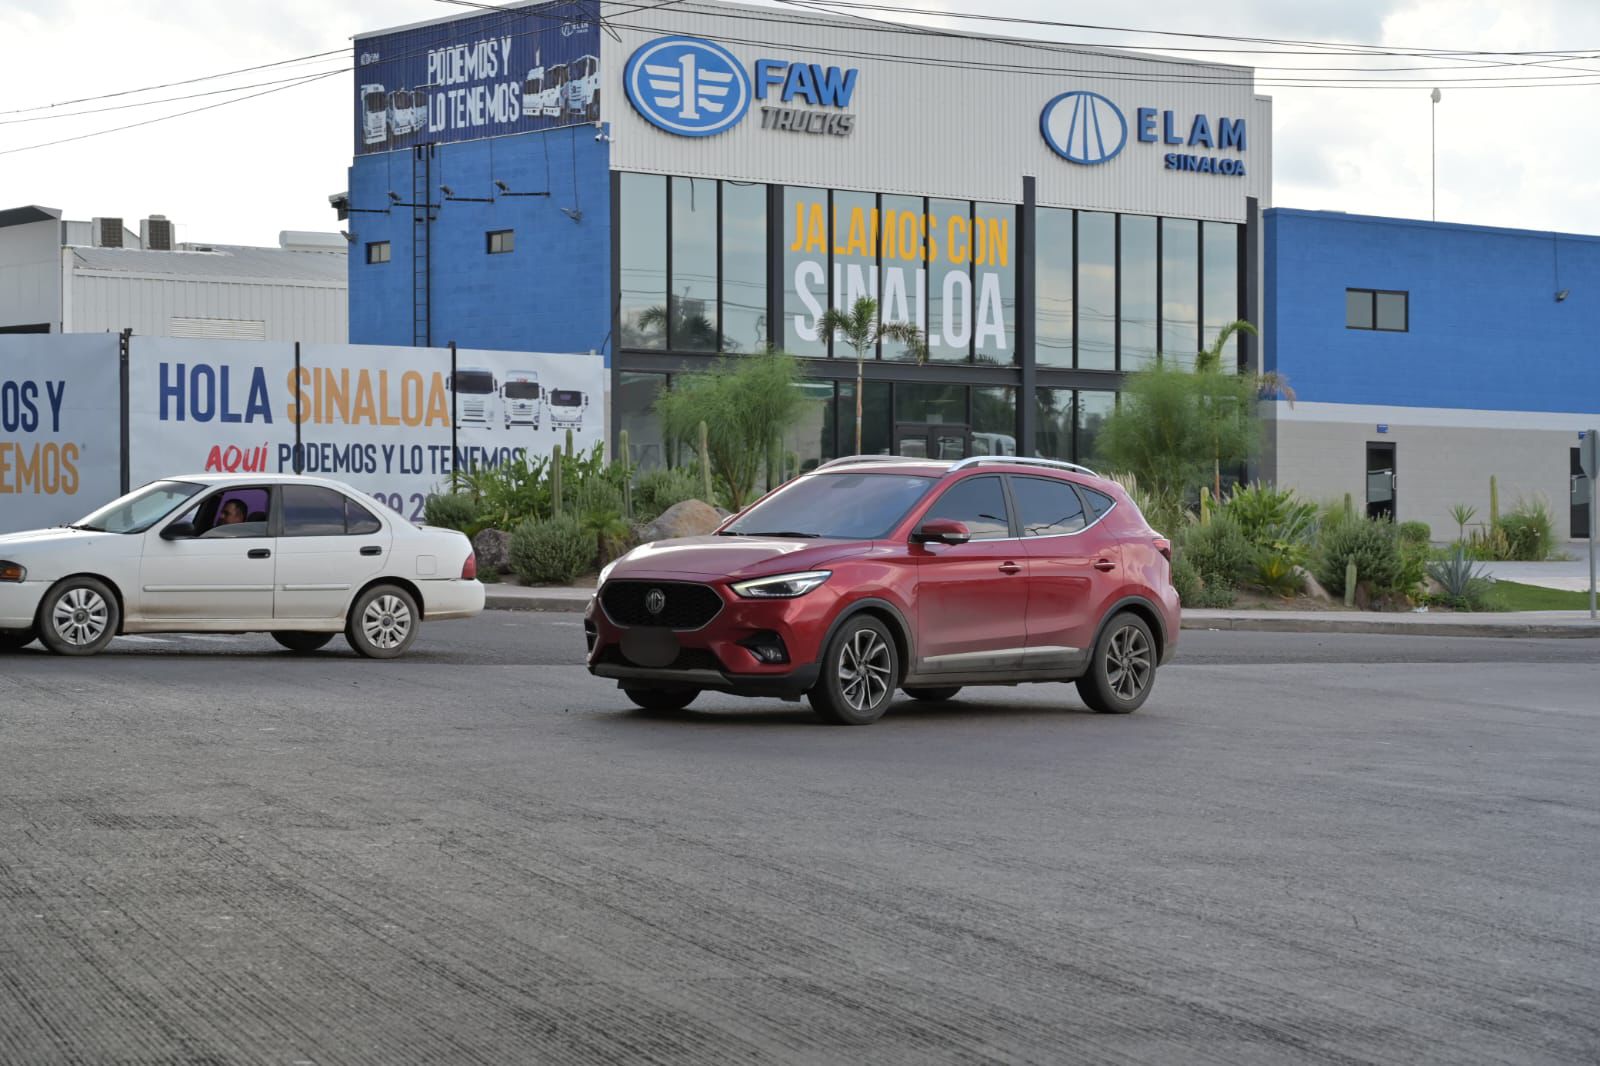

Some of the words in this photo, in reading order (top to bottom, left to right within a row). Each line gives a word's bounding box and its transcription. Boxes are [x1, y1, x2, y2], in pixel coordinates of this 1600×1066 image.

[428, 38, 498, 86] PODEMOS
[500, 35, 513, 76] Y
[755, 58, 859, 108] FAW
[429, 91, 444, 133] LO
[448, 81, 520, 129] TENEMOS
[761, 105, 856, 136] TRUCKS
[1137, 107, 1247, 150] ELAM
[1164, 152, 1246, 176] SINALOA
[791, 201, 938, 263] JALAMOS
[947, 214, 1009, 267] CON
[793, 260, 1007, 349] SINALOA
[2, 380, 39, 433] OS
[45, 380, 66, 432] Y
[159, 362, 273, 424] HOLA
[287, 365, 450, 427] SINALOA
[0, 442, 79, 496] EMOS
[205, 441, 269, 472] AQUÍ
[278, 443, 377, 475] PODEMOS
[381, 444, 395, 474] Y
[400, 445, 423, 475] LO
